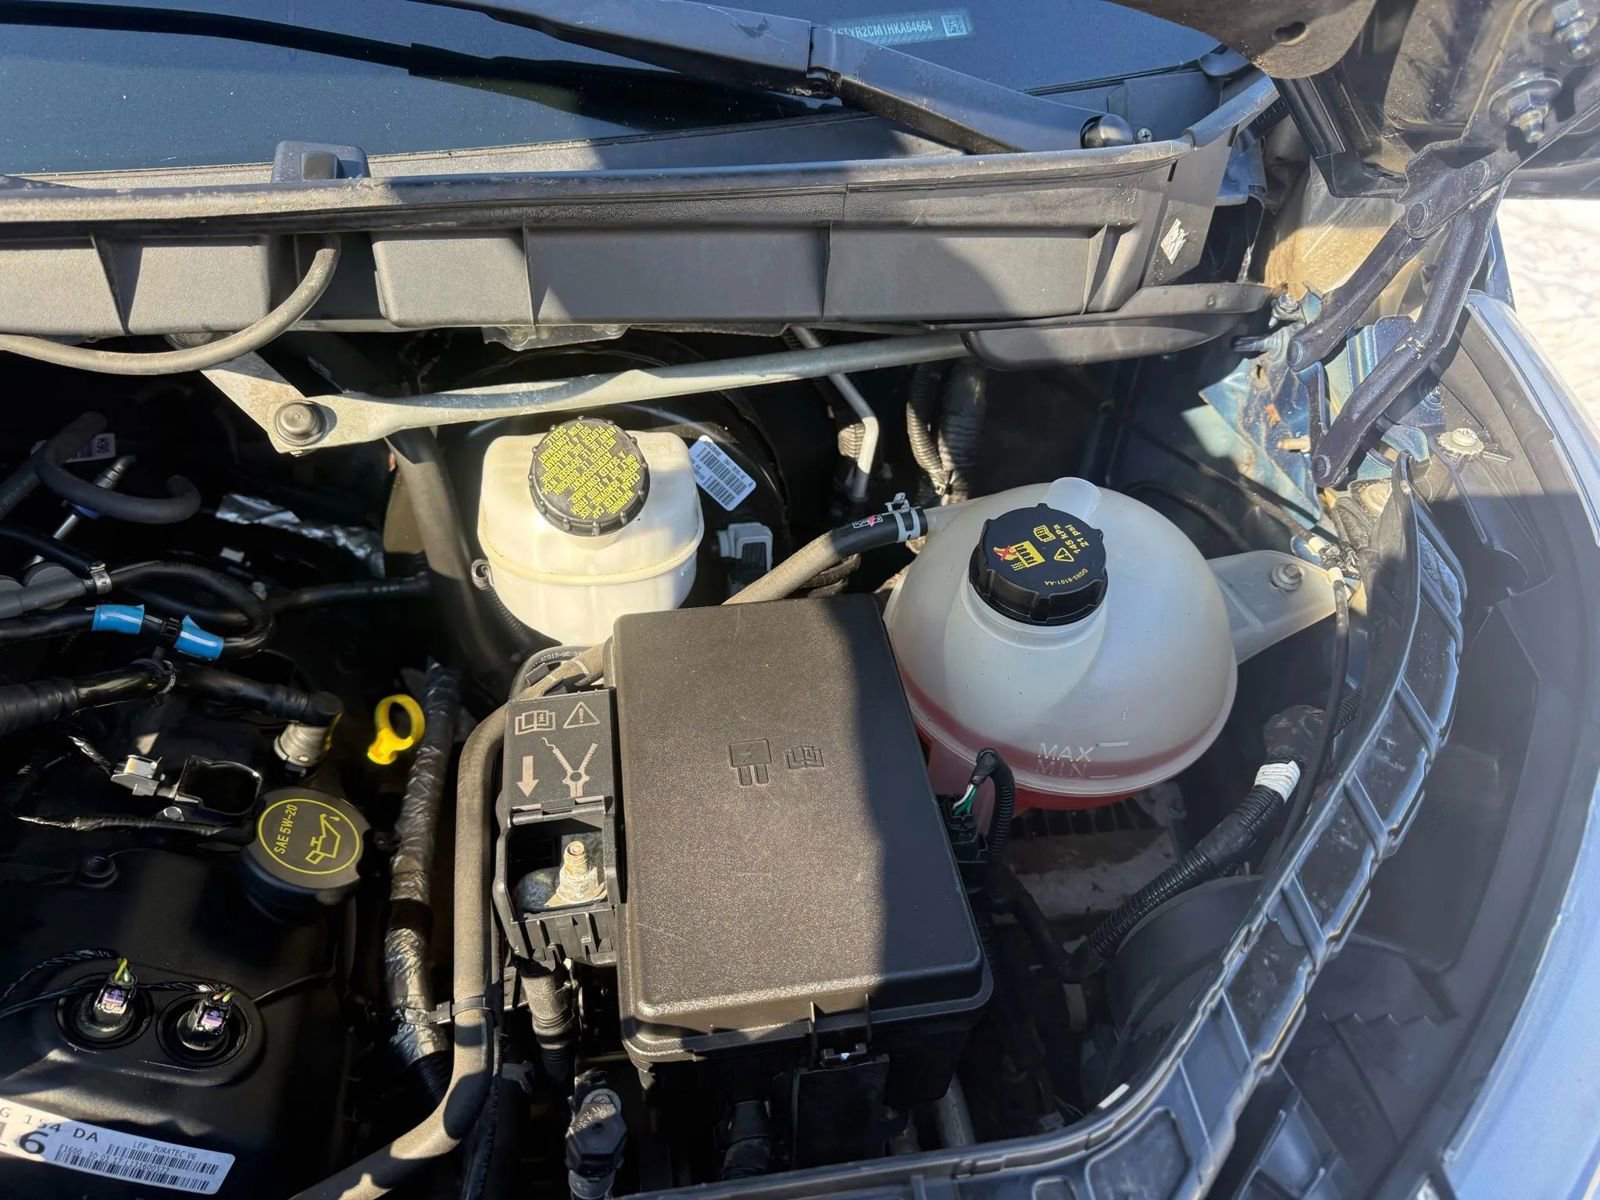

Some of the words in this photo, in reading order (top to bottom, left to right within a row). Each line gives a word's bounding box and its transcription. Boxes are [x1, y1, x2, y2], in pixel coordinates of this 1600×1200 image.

[567, 422, 584, 437] D'UN
[578, 426, 592, 439] DOT
[582, 425, 605, 446] PLOYER
[597, 426, 617, 444] AVANT
[537, 433, 570, 464] CONTENANT
[570, 443, 585, 457] QUE
[580, 449, 591, 460] LE
[588, 437, 616, 463] NETTOYER
[589, 441, 600, 452] DE
[541, 440, 575, 472] PROVENANT
[561, 453, 573, 465] DU
[619, 453, 637, 470] ONLY
[539, 462, 564, 485] LIQUIDE
[579, 461, 590, 471] LE
[598, 456, 621, 478] SEALED
[608, 467, 622, 480] DOT
[618, 461, 641, 482] BEFORE
[552, 469, 581, 496] BOUCHON
[567, 475, 601, 506] CONTAINER.
[586, 482, 605, 500] FLUID
[620, 472, 641, 492] CLEAN
[589, 479, 621, 508] REMOVING.
[603, 489, 623, 508] FILLER
[570, 497, 589, 515] FROM
[577, 506, 592, 520] USE
[591, 505, 605, 520] CAP
[1053, 524, 1069, 540] kPa
[1064, 524, 1082, 537] psi
[1064, 539, 1081, 554] 145
[1076, 537, 1090, 548] 21
[1037, 742, 1094, 762] MAX
[1034, 758, 1088, 777] MIN
[279, 804, 298, 834] 5W-20
[274, 834, 290, 854] SAE
[25, 1113, 62, 1133] 154
[72, 1127, 99, 1144] DA
[132, 1141, 148, 1150] LEP
[152, 1144, 186, 1158] DURATEC
[186, 1151, 197, 1160] V6
